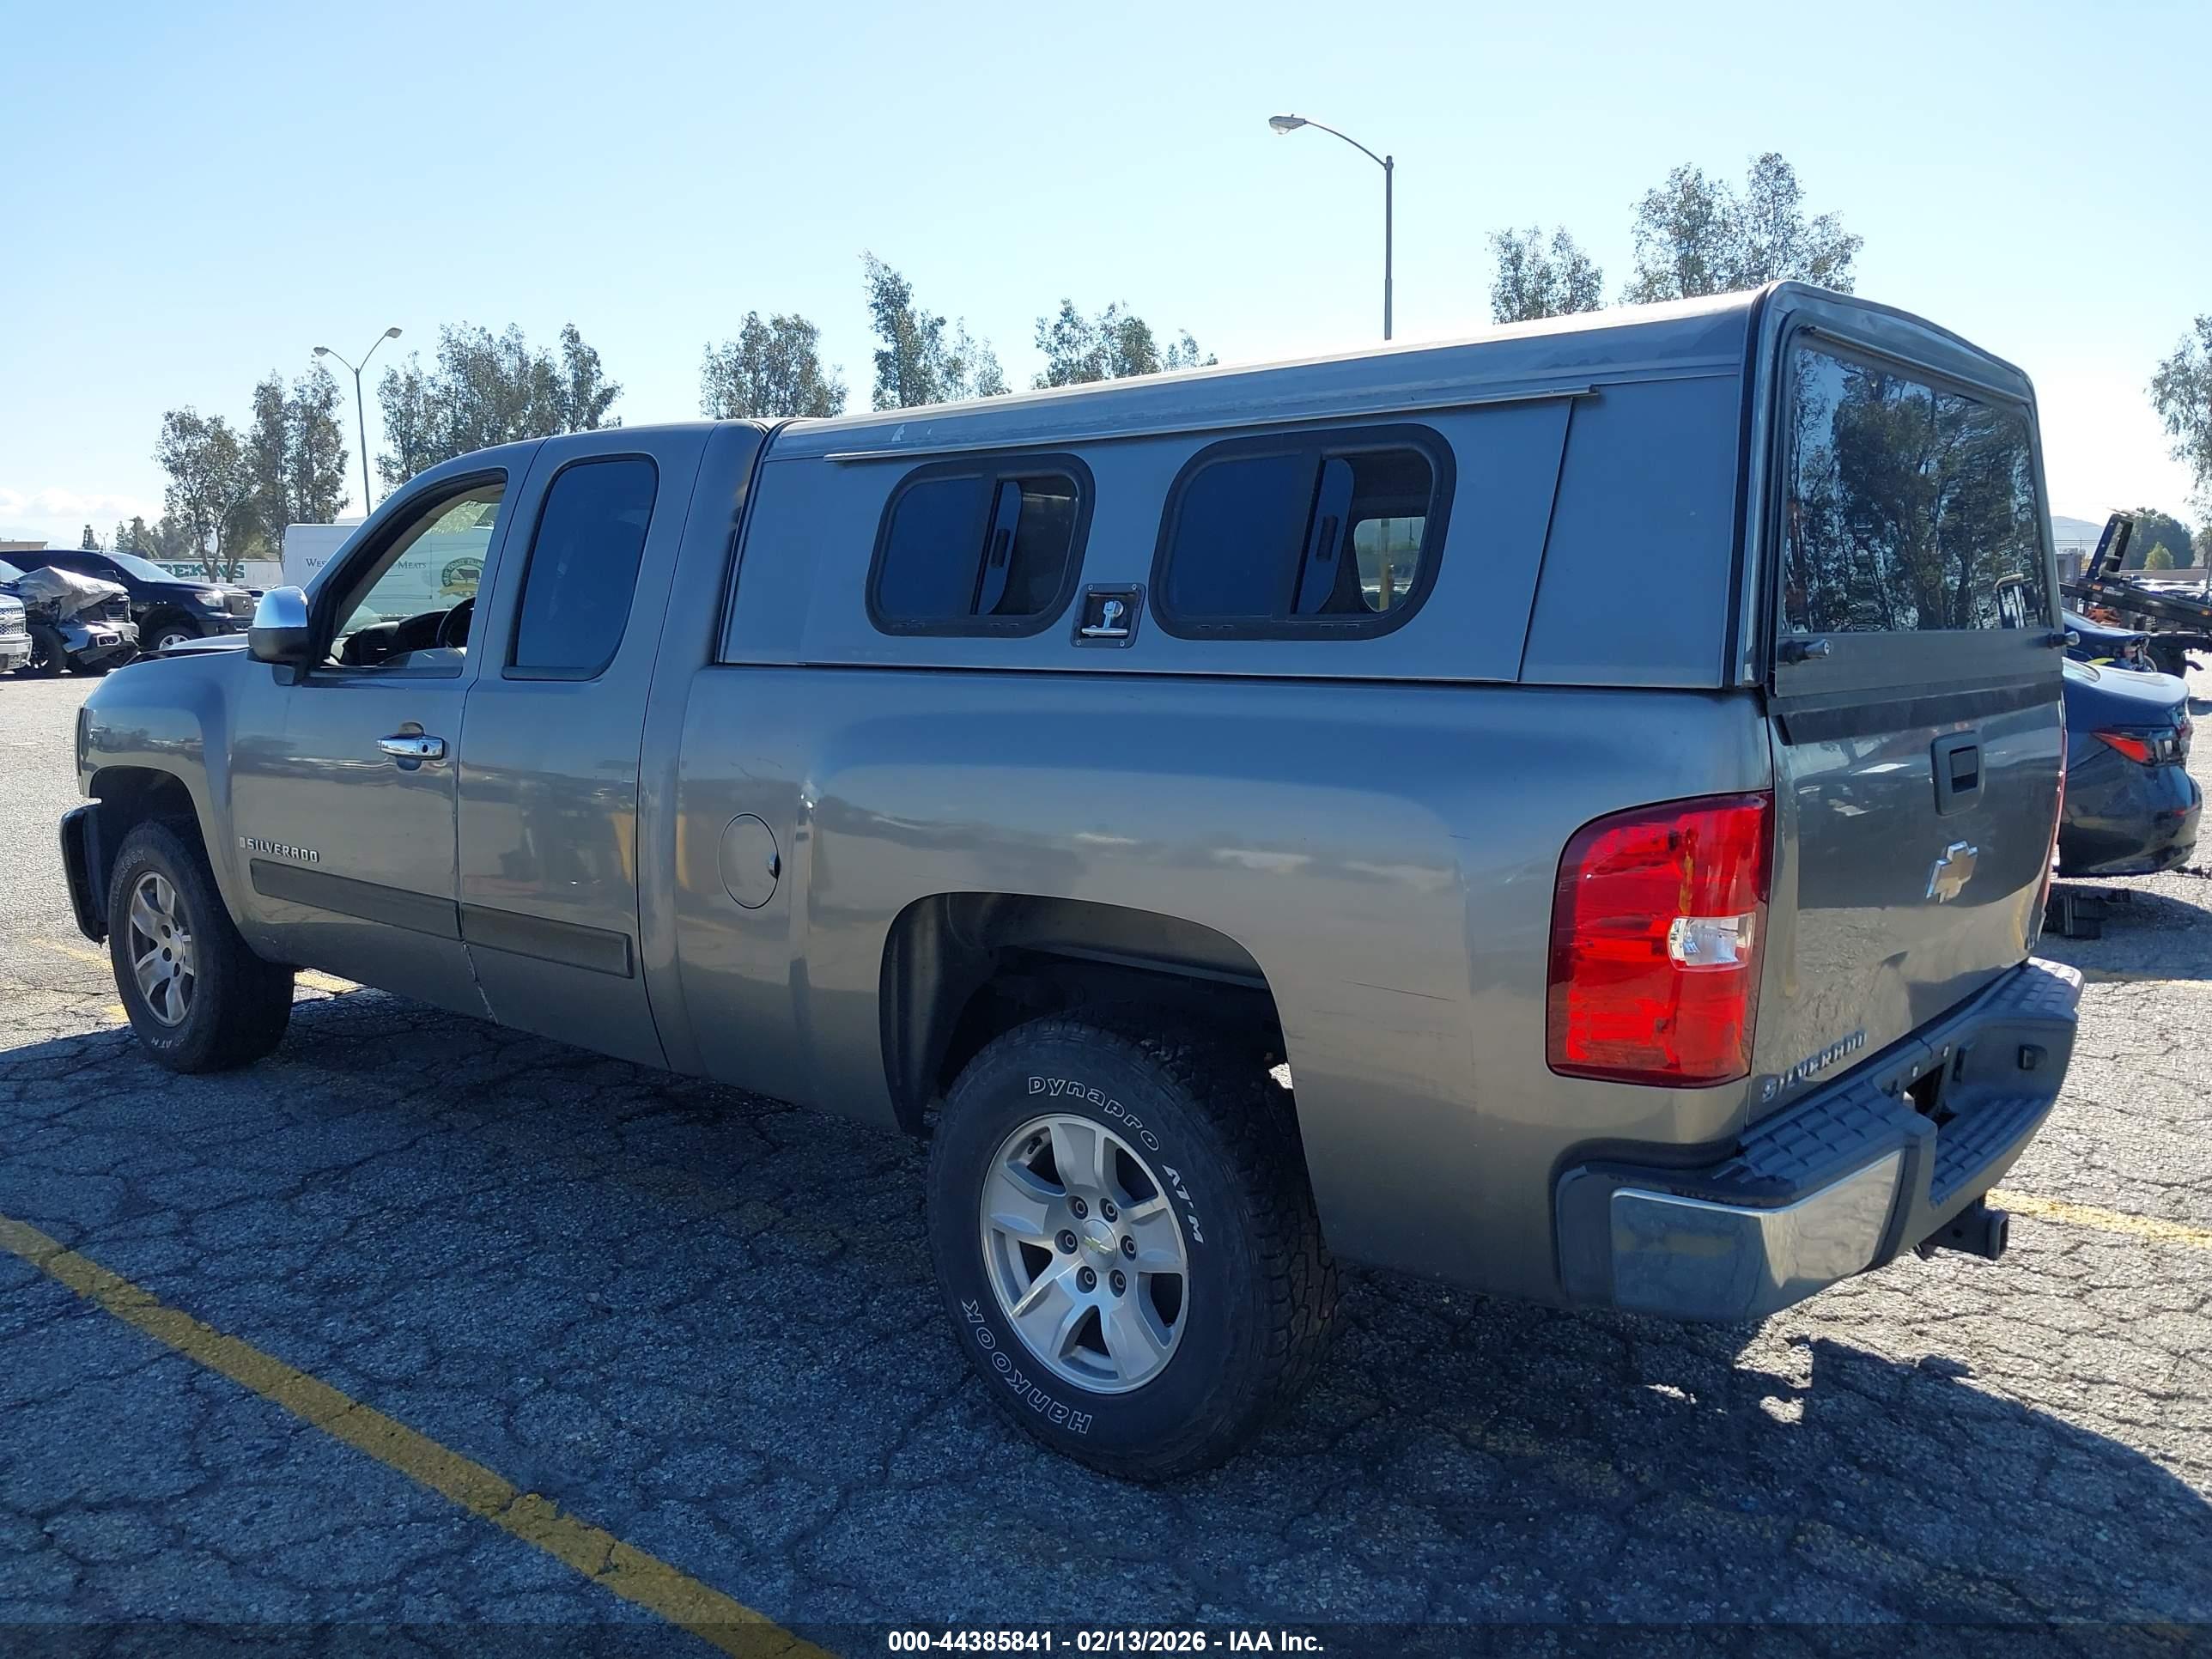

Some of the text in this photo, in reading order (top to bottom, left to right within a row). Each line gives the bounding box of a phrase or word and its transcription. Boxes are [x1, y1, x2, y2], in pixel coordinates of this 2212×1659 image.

[155, 563, 246, 579] BEKNS
[306, 558, 327, 568] WES
[398, 560, 427, 569] MEATS
[247, 838, 319, 862] SILVERADO
[1028, 1075, 1160, 1152] Dynapro
